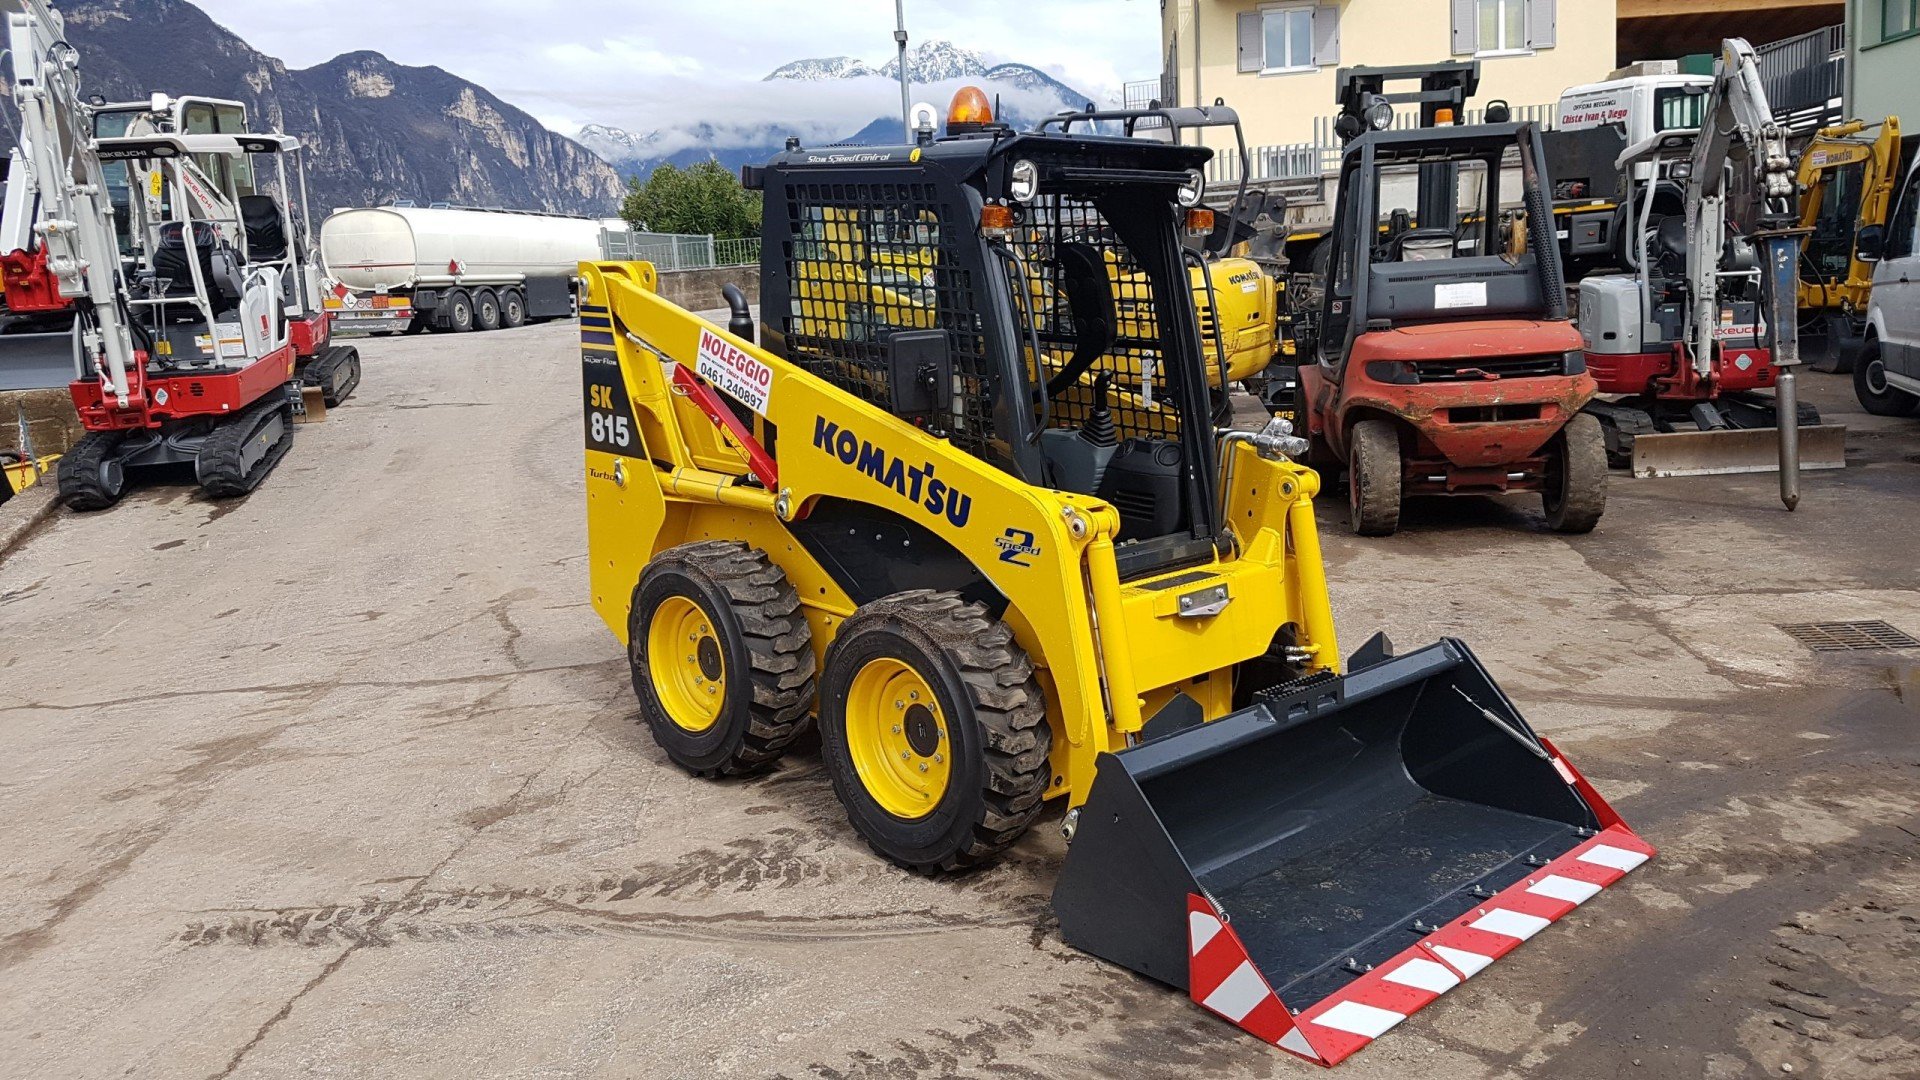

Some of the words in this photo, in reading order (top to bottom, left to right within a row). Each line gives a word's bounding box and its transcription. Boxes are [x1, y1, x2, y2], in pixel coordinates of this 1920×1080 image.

[1585, 112, 1600, 122] Ivan
[1608, 109, 1628, 119] Diego
[701, 332, 770, 387] NOLEGGIO
[590, 384, 613, 409] SK
[700, 362, 763, 410] 0461.240897
[591, 411, 630, 447] 815
[588, 467, 616, 481] Turbo
[813, 415, 972, 528] KOMATSU
[999, 527, 1034, 567] 2
